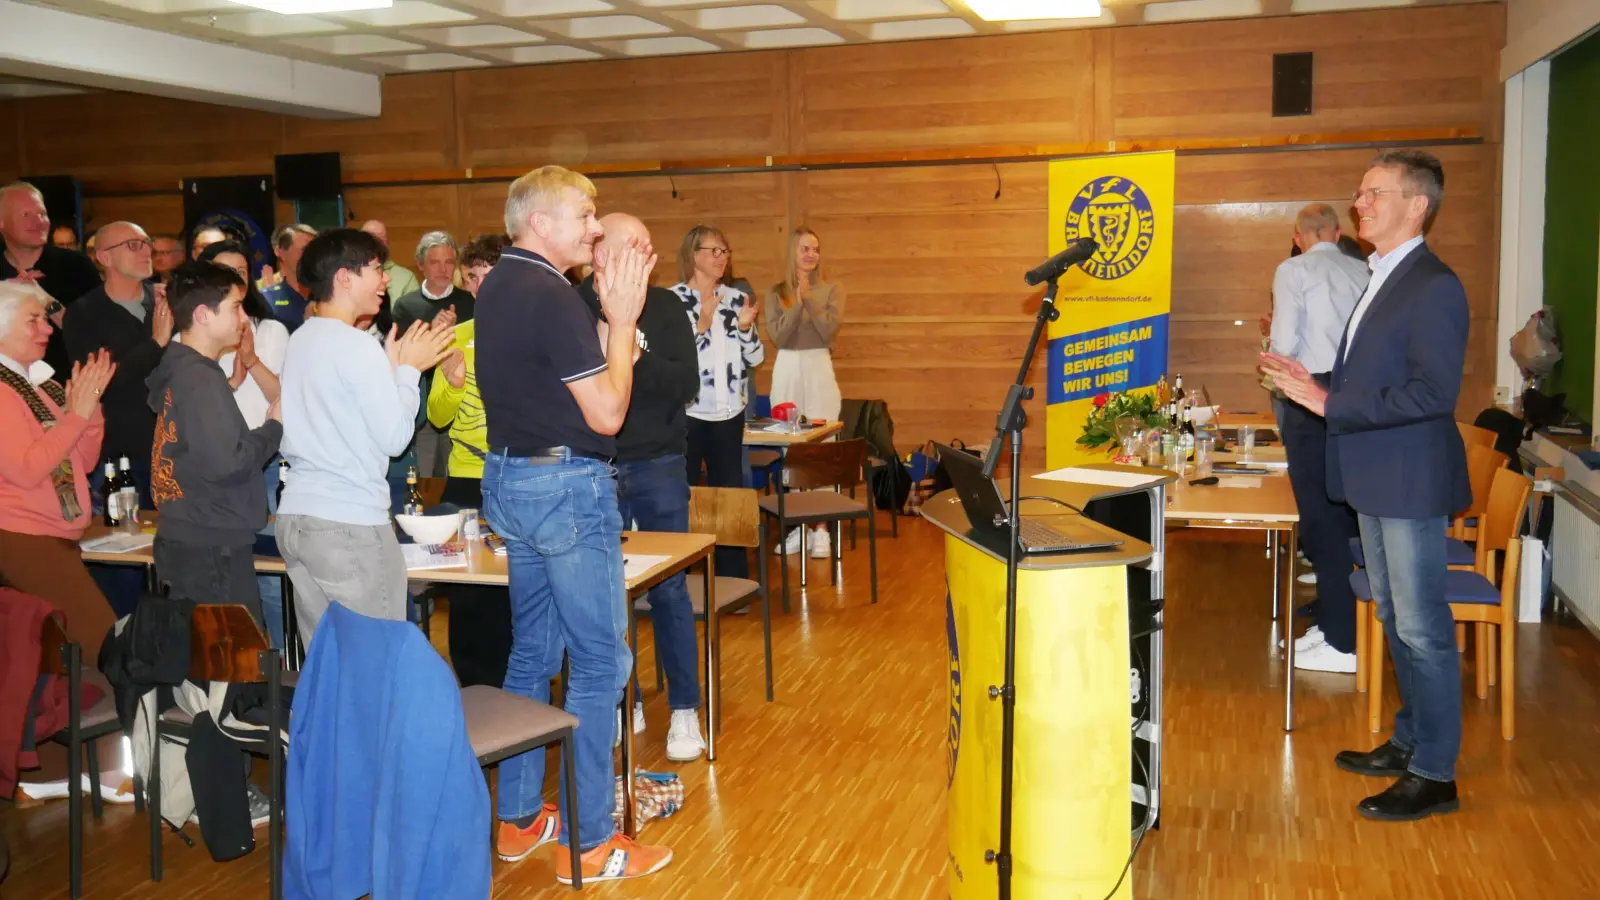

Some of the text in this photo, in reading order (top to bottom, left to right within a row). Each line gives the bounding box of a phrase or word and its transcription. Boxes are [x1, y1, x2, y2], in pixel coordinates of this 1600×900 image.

[1079, 177, 1137, 201] VfL
[1064, 295, 1152, 303] www.vfl-badnenndorf.de
[1064, 325, 1153, 357] GEMEINSAM
[1064, 349, 1135, 376] BEWEGEN
[1063, 369, 1129, 394] WIR UNS!
